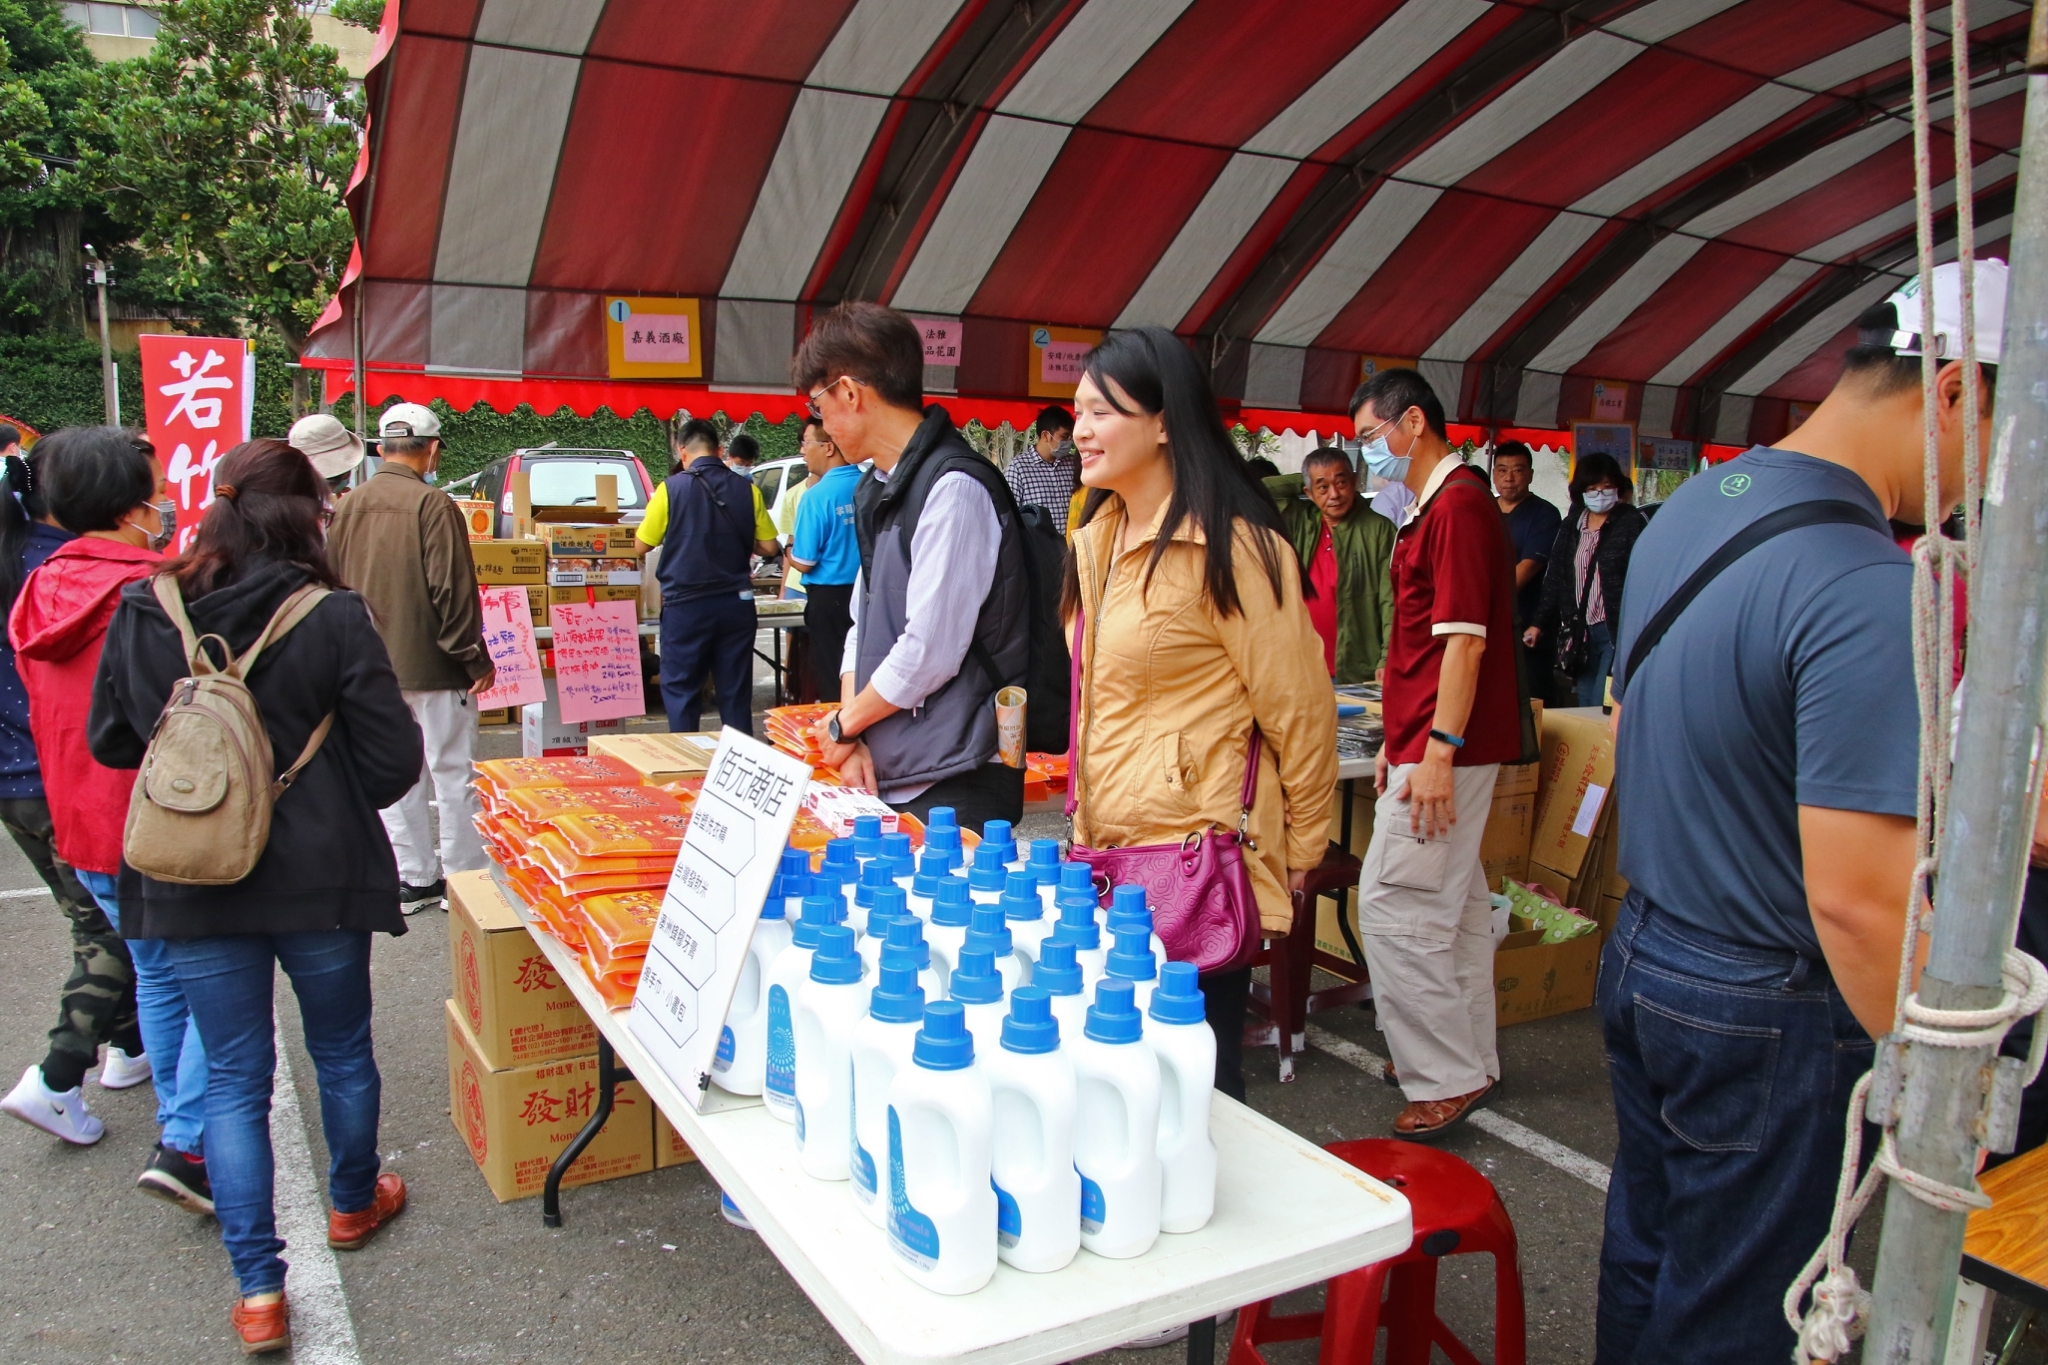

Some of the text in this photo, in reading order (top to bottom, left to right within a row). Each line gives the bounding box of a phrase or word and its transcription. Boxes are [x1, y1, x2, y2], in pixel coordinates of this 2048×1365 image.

[631, 330, 685, 344] 嘉義酒廠
[925, 329, 947, 339] 法雅
[1034, 329, 1048, 344] 2
[925, 345, 956, 357] 品花園
[1364, 359, 1375, 374] 3
[1594, 384, 1604, 397] 4
[159, 349, 234, 553] 若竹
[713, 746, 794, 817] 佰元商店
[514, 956, 567, 993] 發
[536, 1058, 600, 1079] 招財進寶 日進
